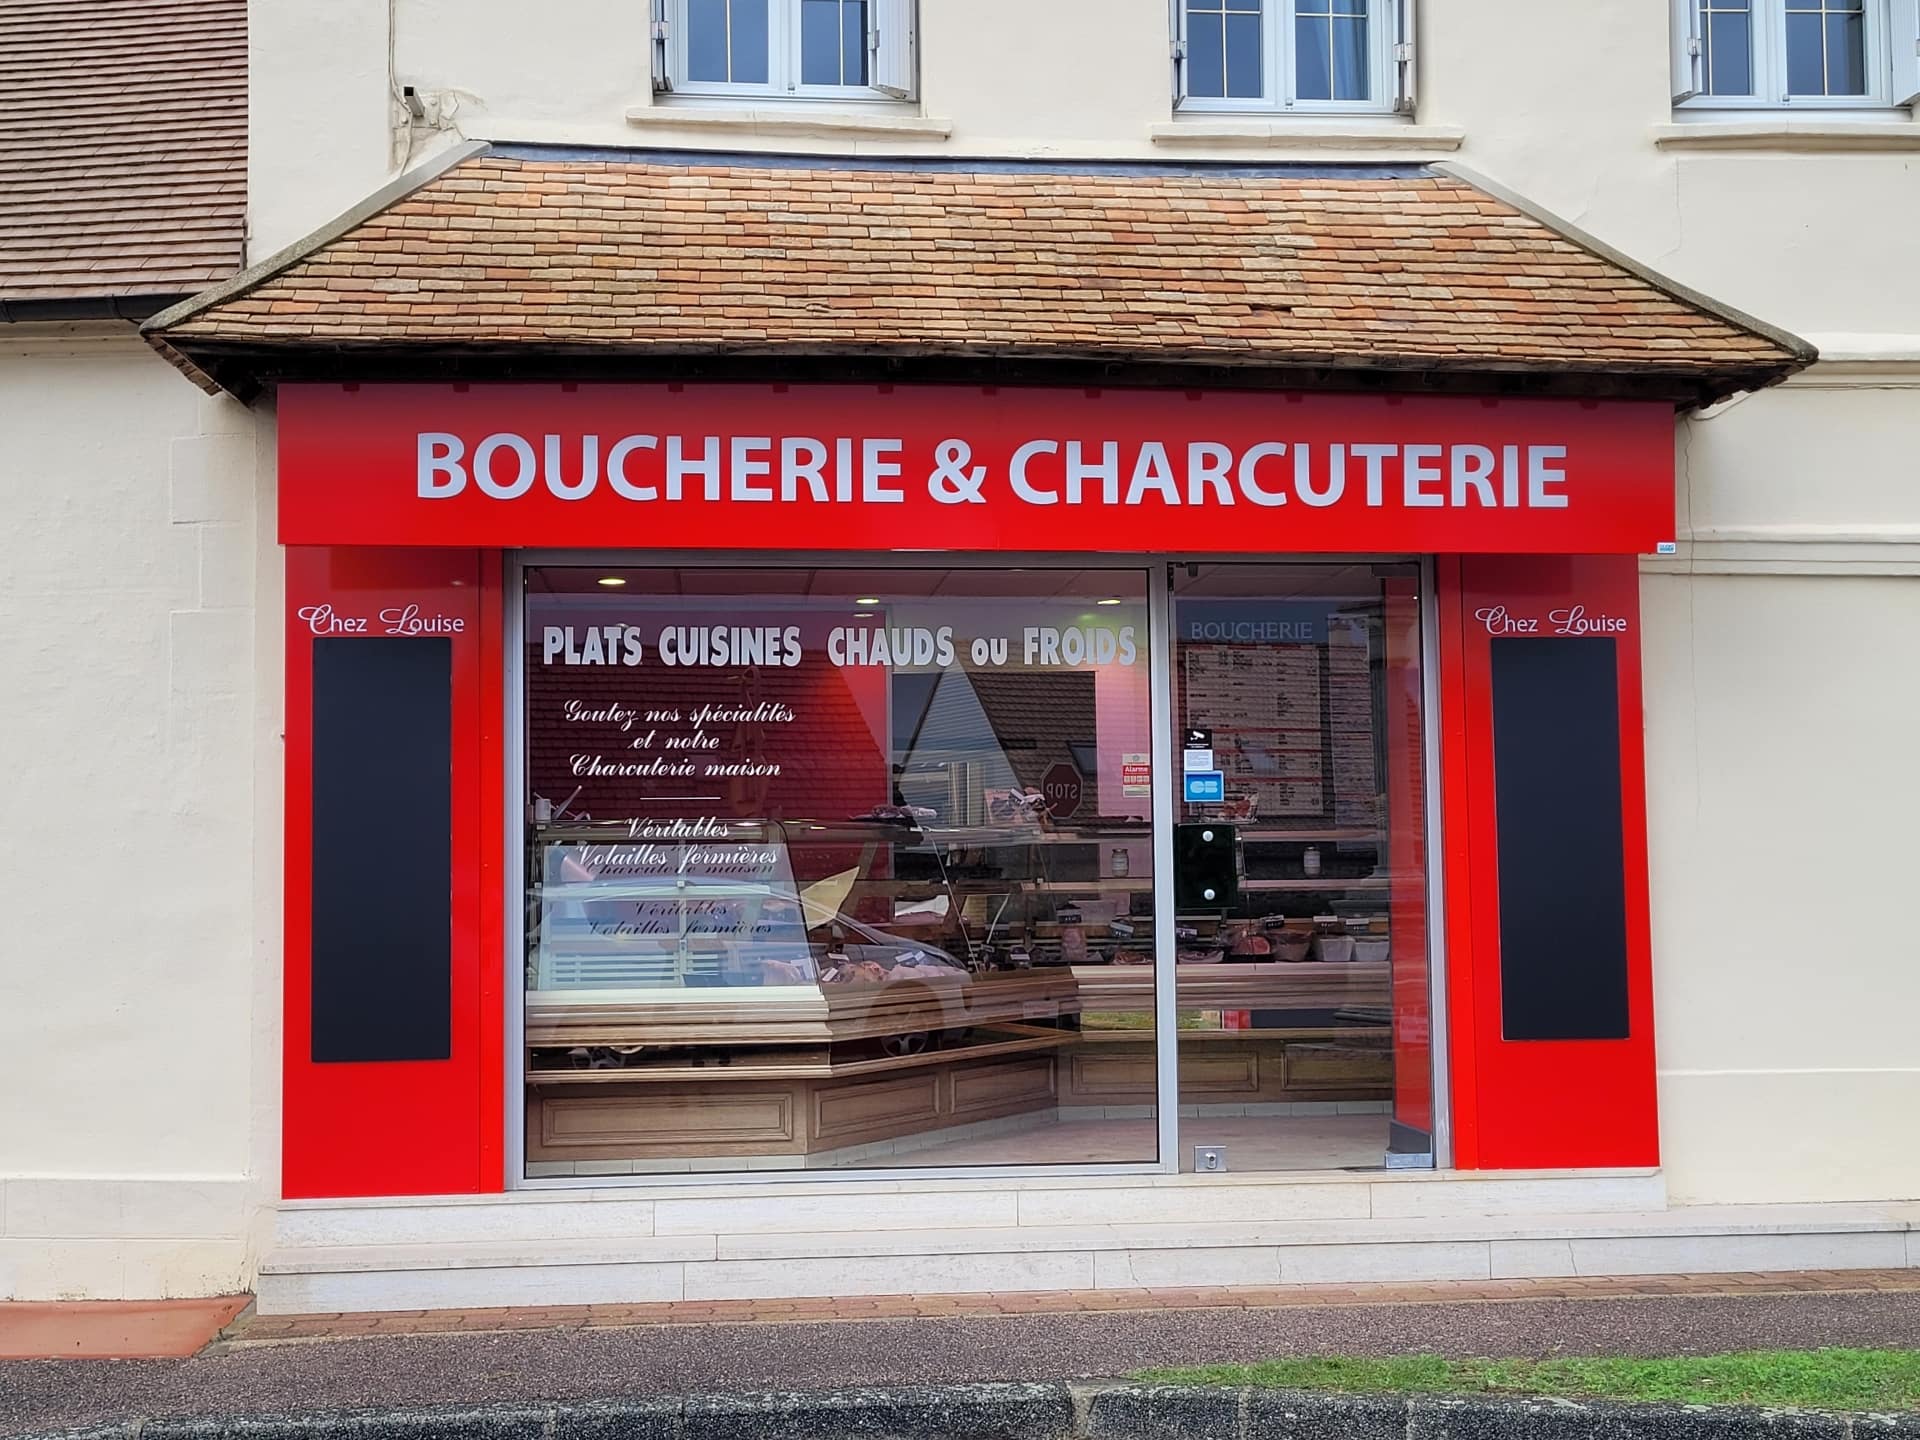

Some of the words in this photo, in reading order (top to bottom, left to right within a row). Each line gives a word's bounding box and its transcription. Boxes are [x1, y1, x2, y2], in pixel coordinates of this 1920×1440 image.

[417, 431, 904, 502] BOUCHERIE
[927, 438, 987, 503] &
[1009, 440, 1569, 507] CHARCUTERIE
[298, 604, 367, 634] Chez
[379, 604, 465, 635] Louise
[1191, 621, 1313, 640] BOUCHERIE
[1475, 605, 1538, 634] Chez
[1549, 605, 1627, 635] Louise
[543, 626, 642, 666] PLATS
[658, 626, 802, 667] CUISINES
[827, 626, 955, 667] CHAUDS
[1023, 626, 1137, 667] FROIDS
[564, 699, 639, 731] Goutez
[644, 707, 682, 723] nos
[689, 701, 796, 730] spécialités
[628, 729, 656, 750] et
[665, 729, 720, 750] notre
[569, 753, 696, 777] Charcuterie
[704, 758, 782, 777] maison
[624, 816, 730, 839] Véritables
[576, 844, 667, 866] Volailles
[677, 844, 778, 874] fermières
